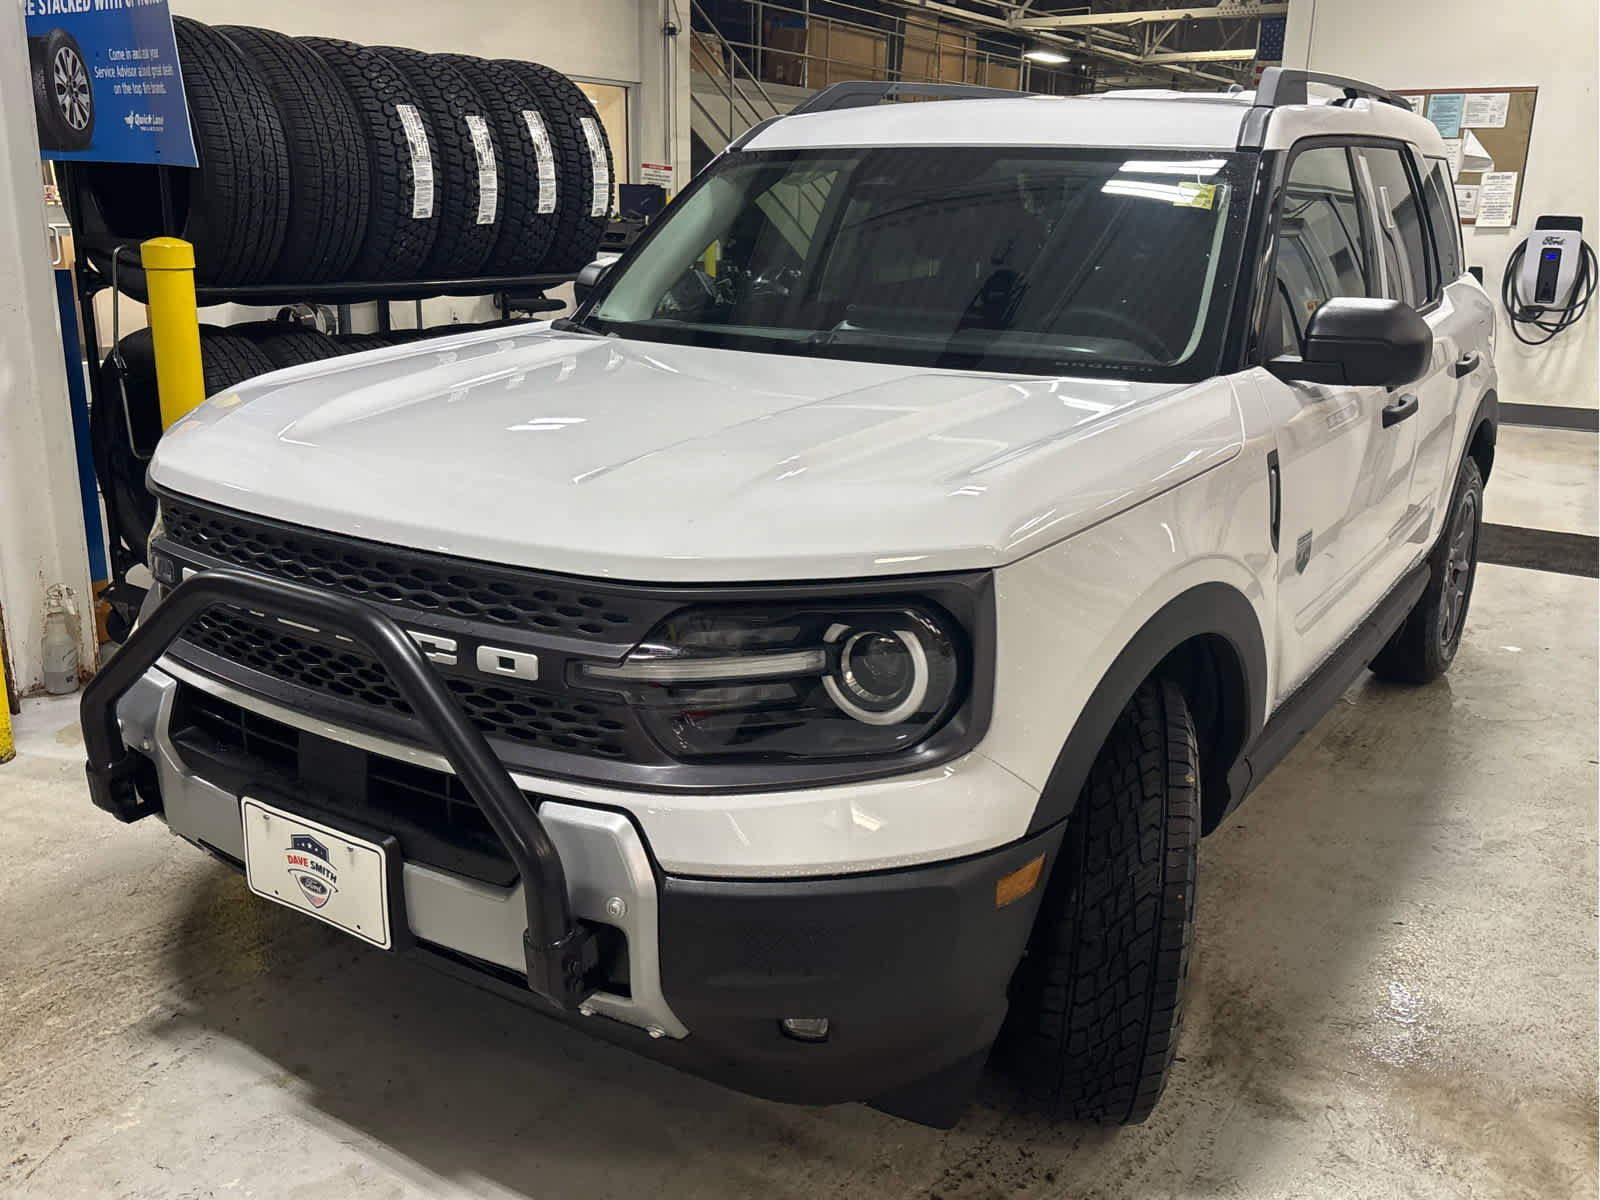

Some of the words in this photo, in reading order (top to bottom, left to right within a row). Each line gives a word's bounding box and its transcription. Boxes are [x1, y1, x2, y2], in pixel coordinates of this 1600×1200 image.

[108, 48, 125, 60] Come
[94, 66, 116, 78] Service
[116, 65, 137, 77] Advisor
[113, 85, 121, 94] on
[122, 83, 132, 94] the
[135, 113, 152, 126] Quick
[1542, 236, 1566, 246] Ford
[287, 854, 309, 867] DAVE
[310, 860, 337, 883] SMITH
[304, 879, 323, 893] Ford
